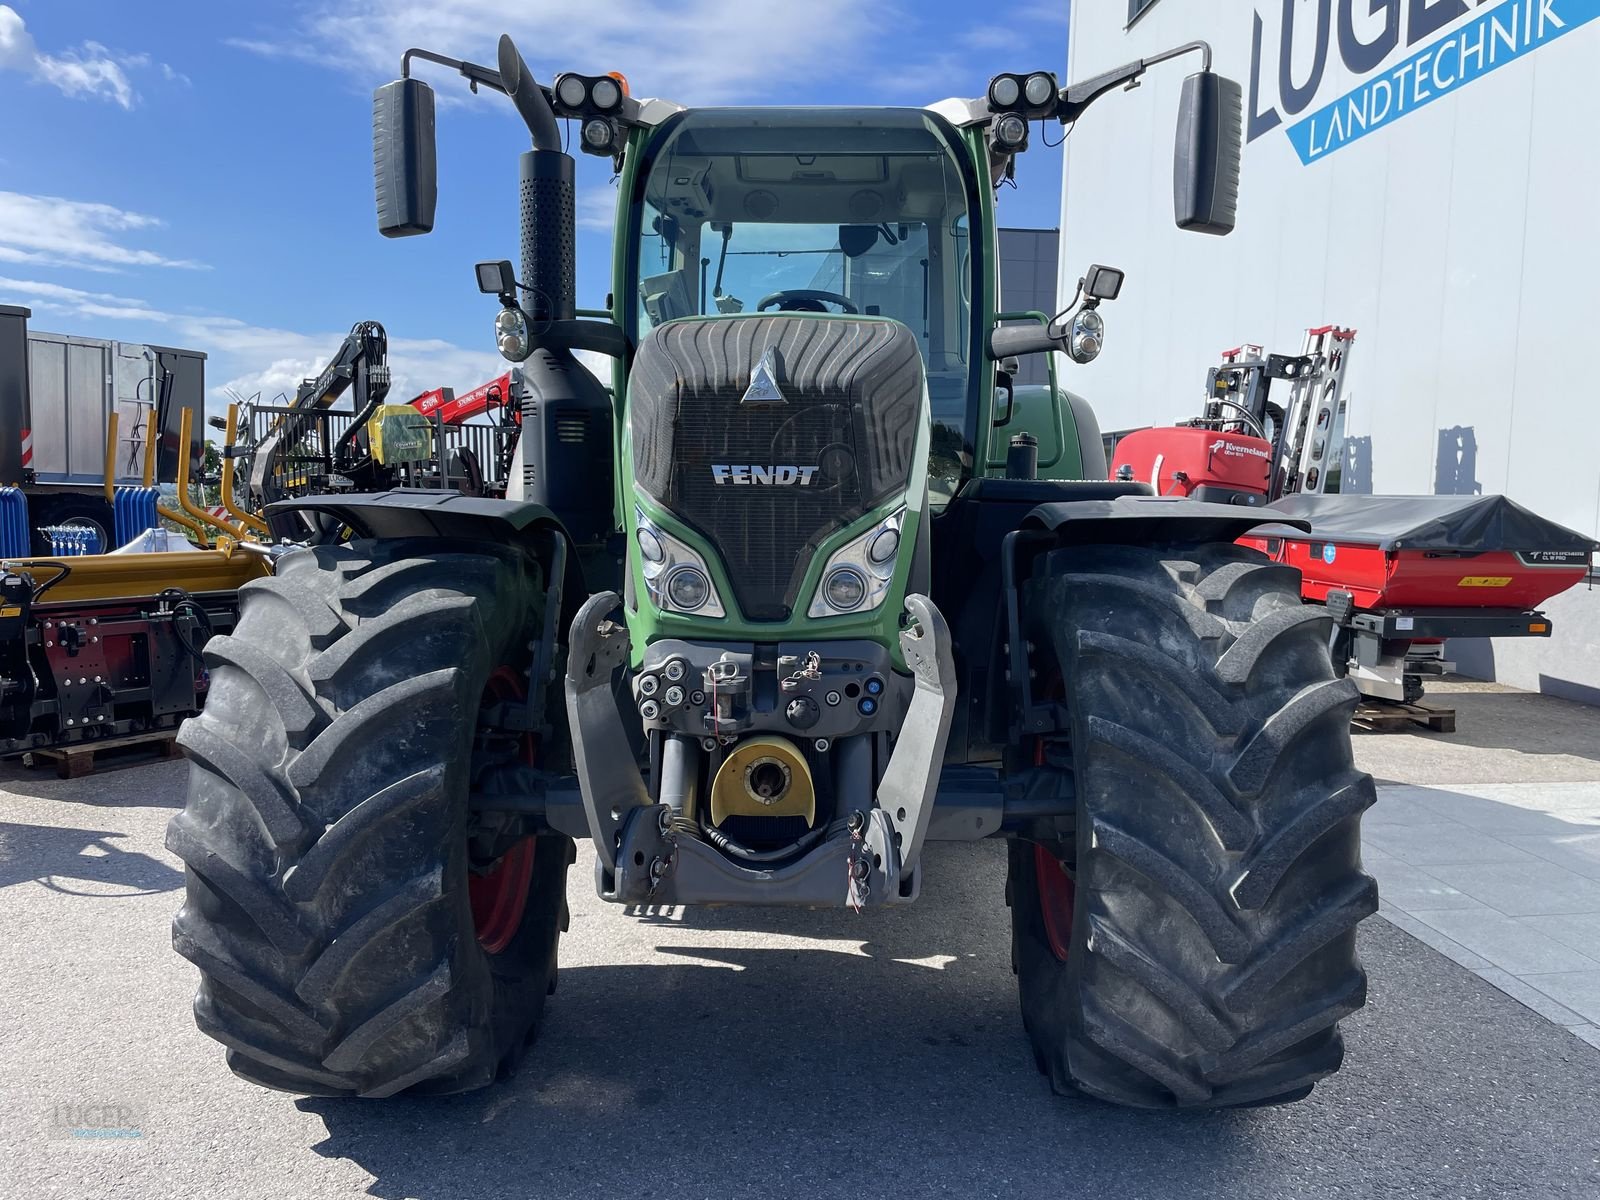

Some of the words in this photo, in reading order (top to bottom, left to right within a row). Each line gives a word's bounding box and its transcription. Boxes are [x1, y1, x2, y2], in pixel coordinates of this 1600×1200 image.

[1308, 0, 1568, 158] LANDTECHNIK
[1226, 442, 1268, 458] Kverneland
[711, 464, 820, 485] FENDT
